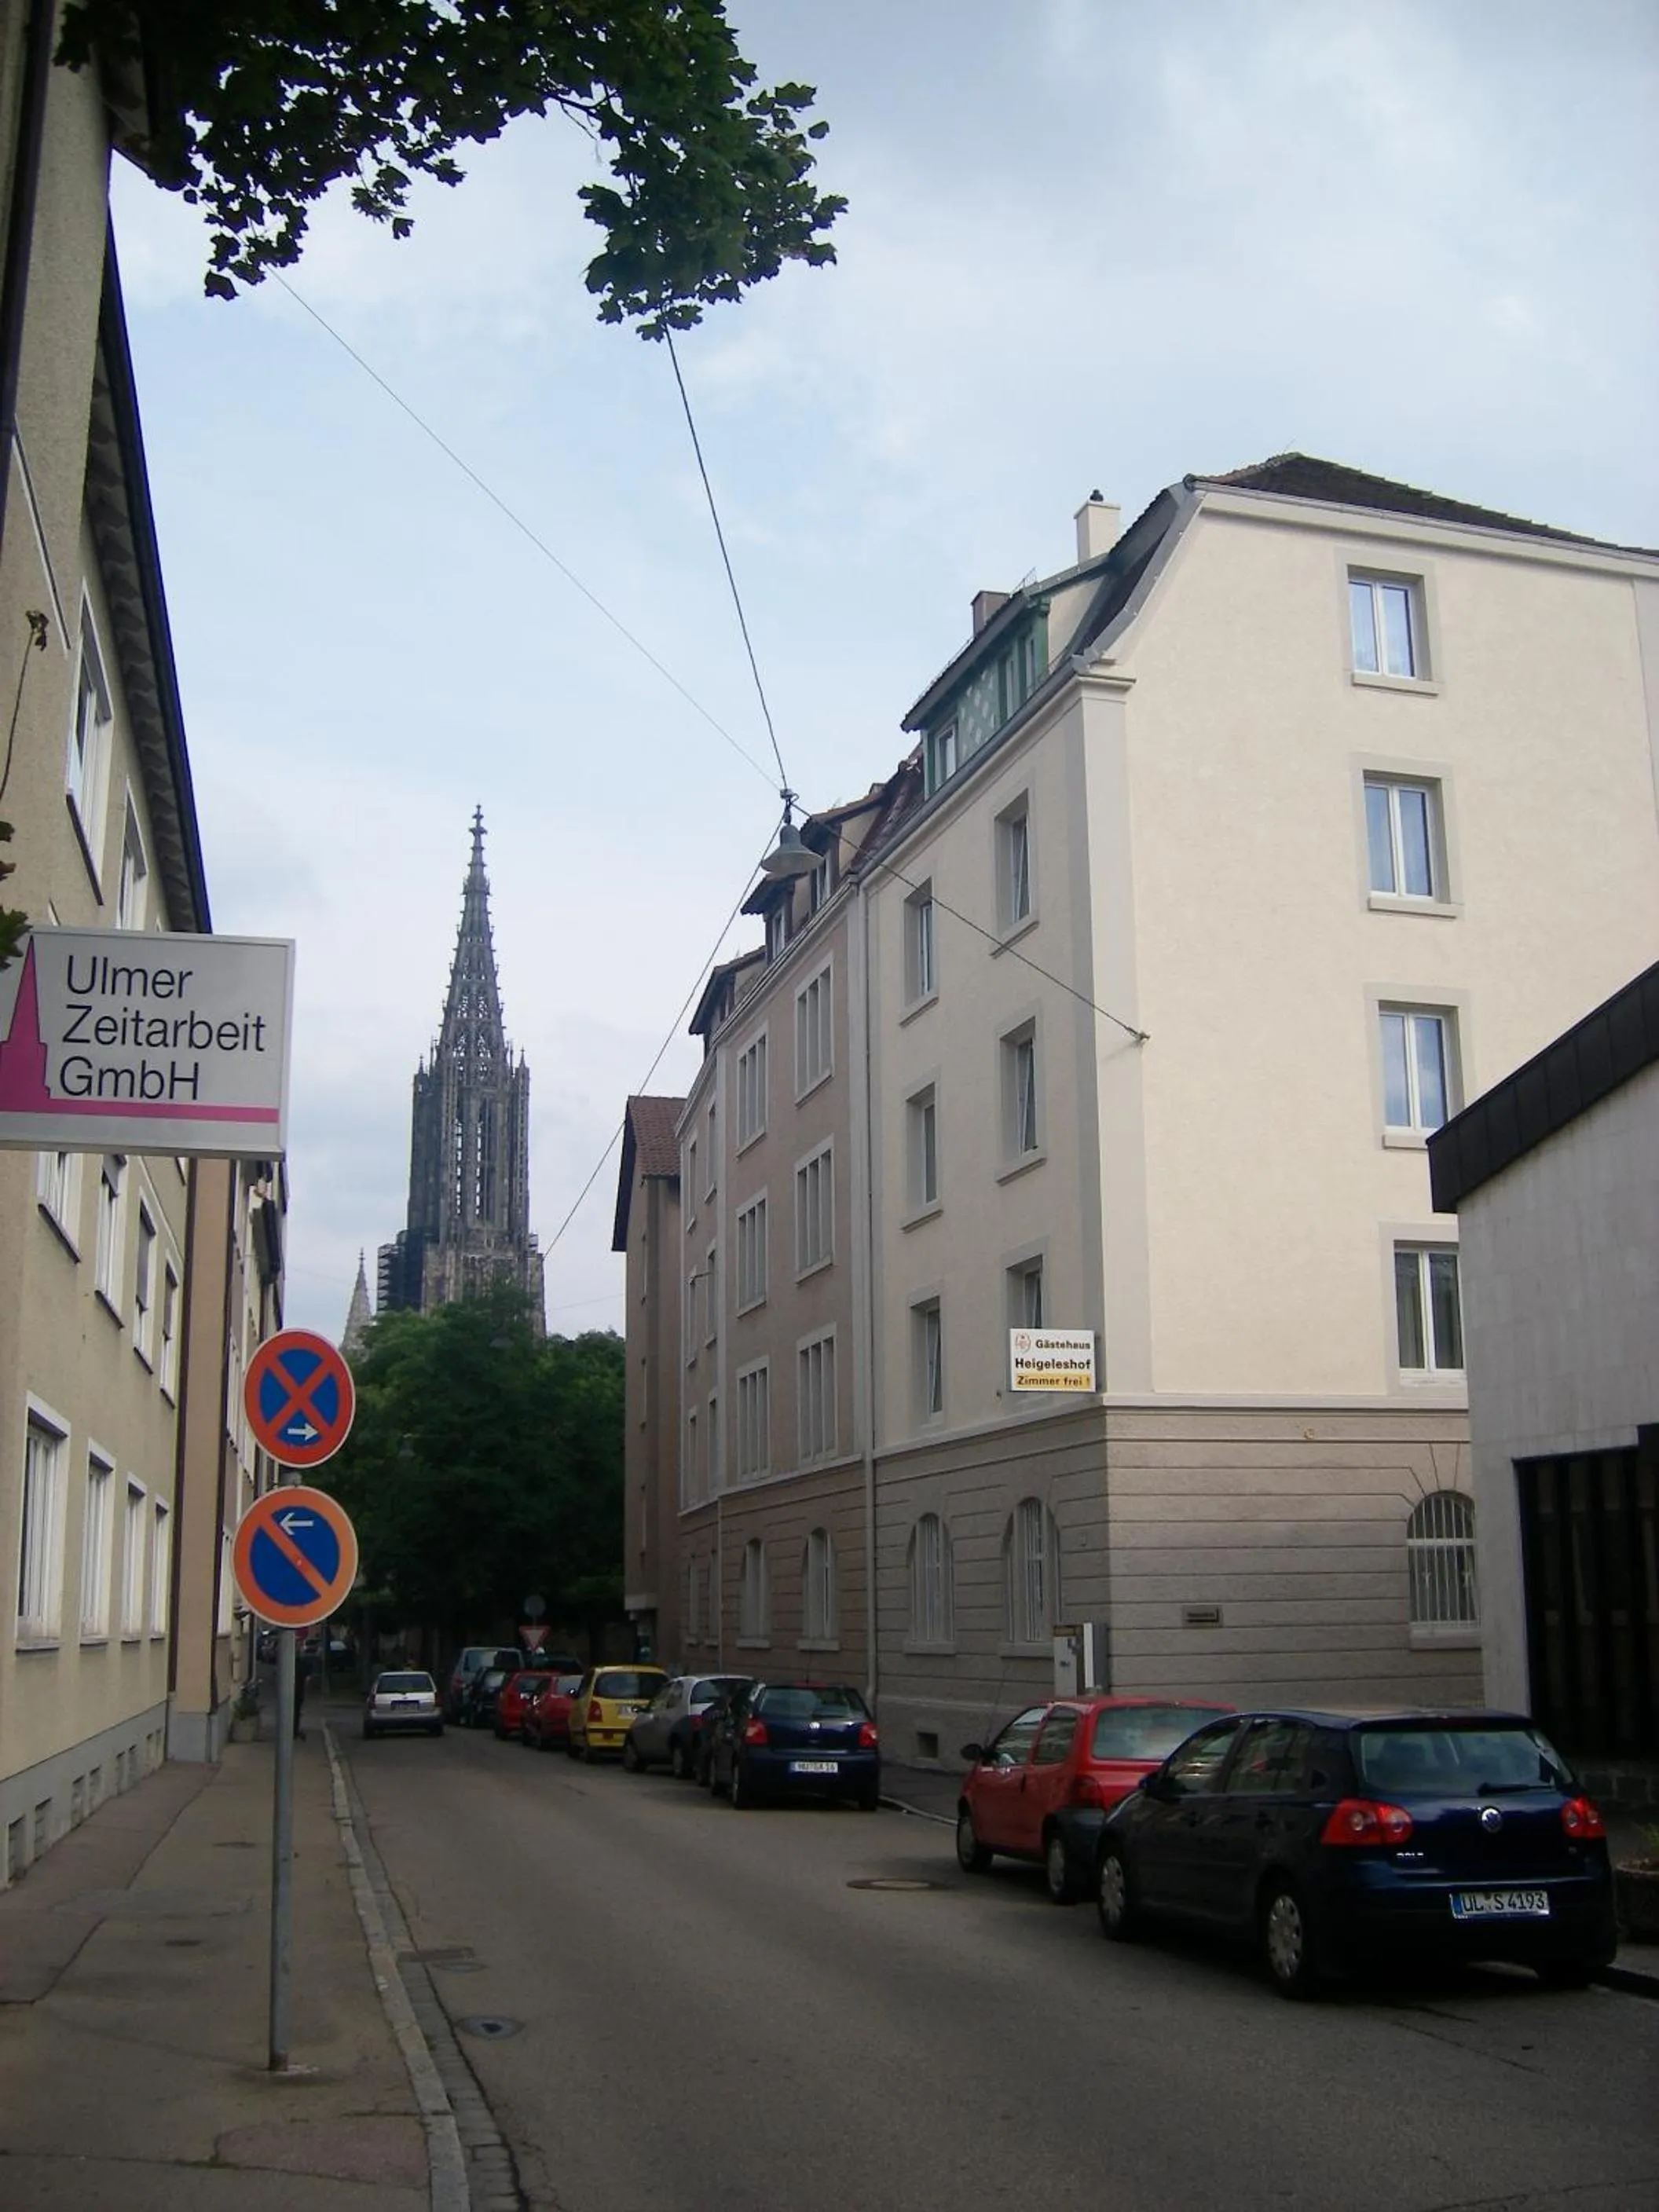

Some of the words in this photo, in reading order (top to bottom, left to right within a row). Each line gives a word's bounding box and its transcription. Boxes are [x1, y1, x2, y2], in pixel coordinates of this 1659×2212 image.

[68, 954, 193, 998] Ulmer
[62, 1004, 266, 1053] Zeitarbeit
[60, 1056, 200, 1100] GmbH
[1035, 1339, 1091, 1350] Gästehaus
[1015, 1358, 1091, 1371] Heigeleshof
[1017, 1375, 1060, 1386] Zimmer
[1507, 1892, 1544, 1910] 4193
